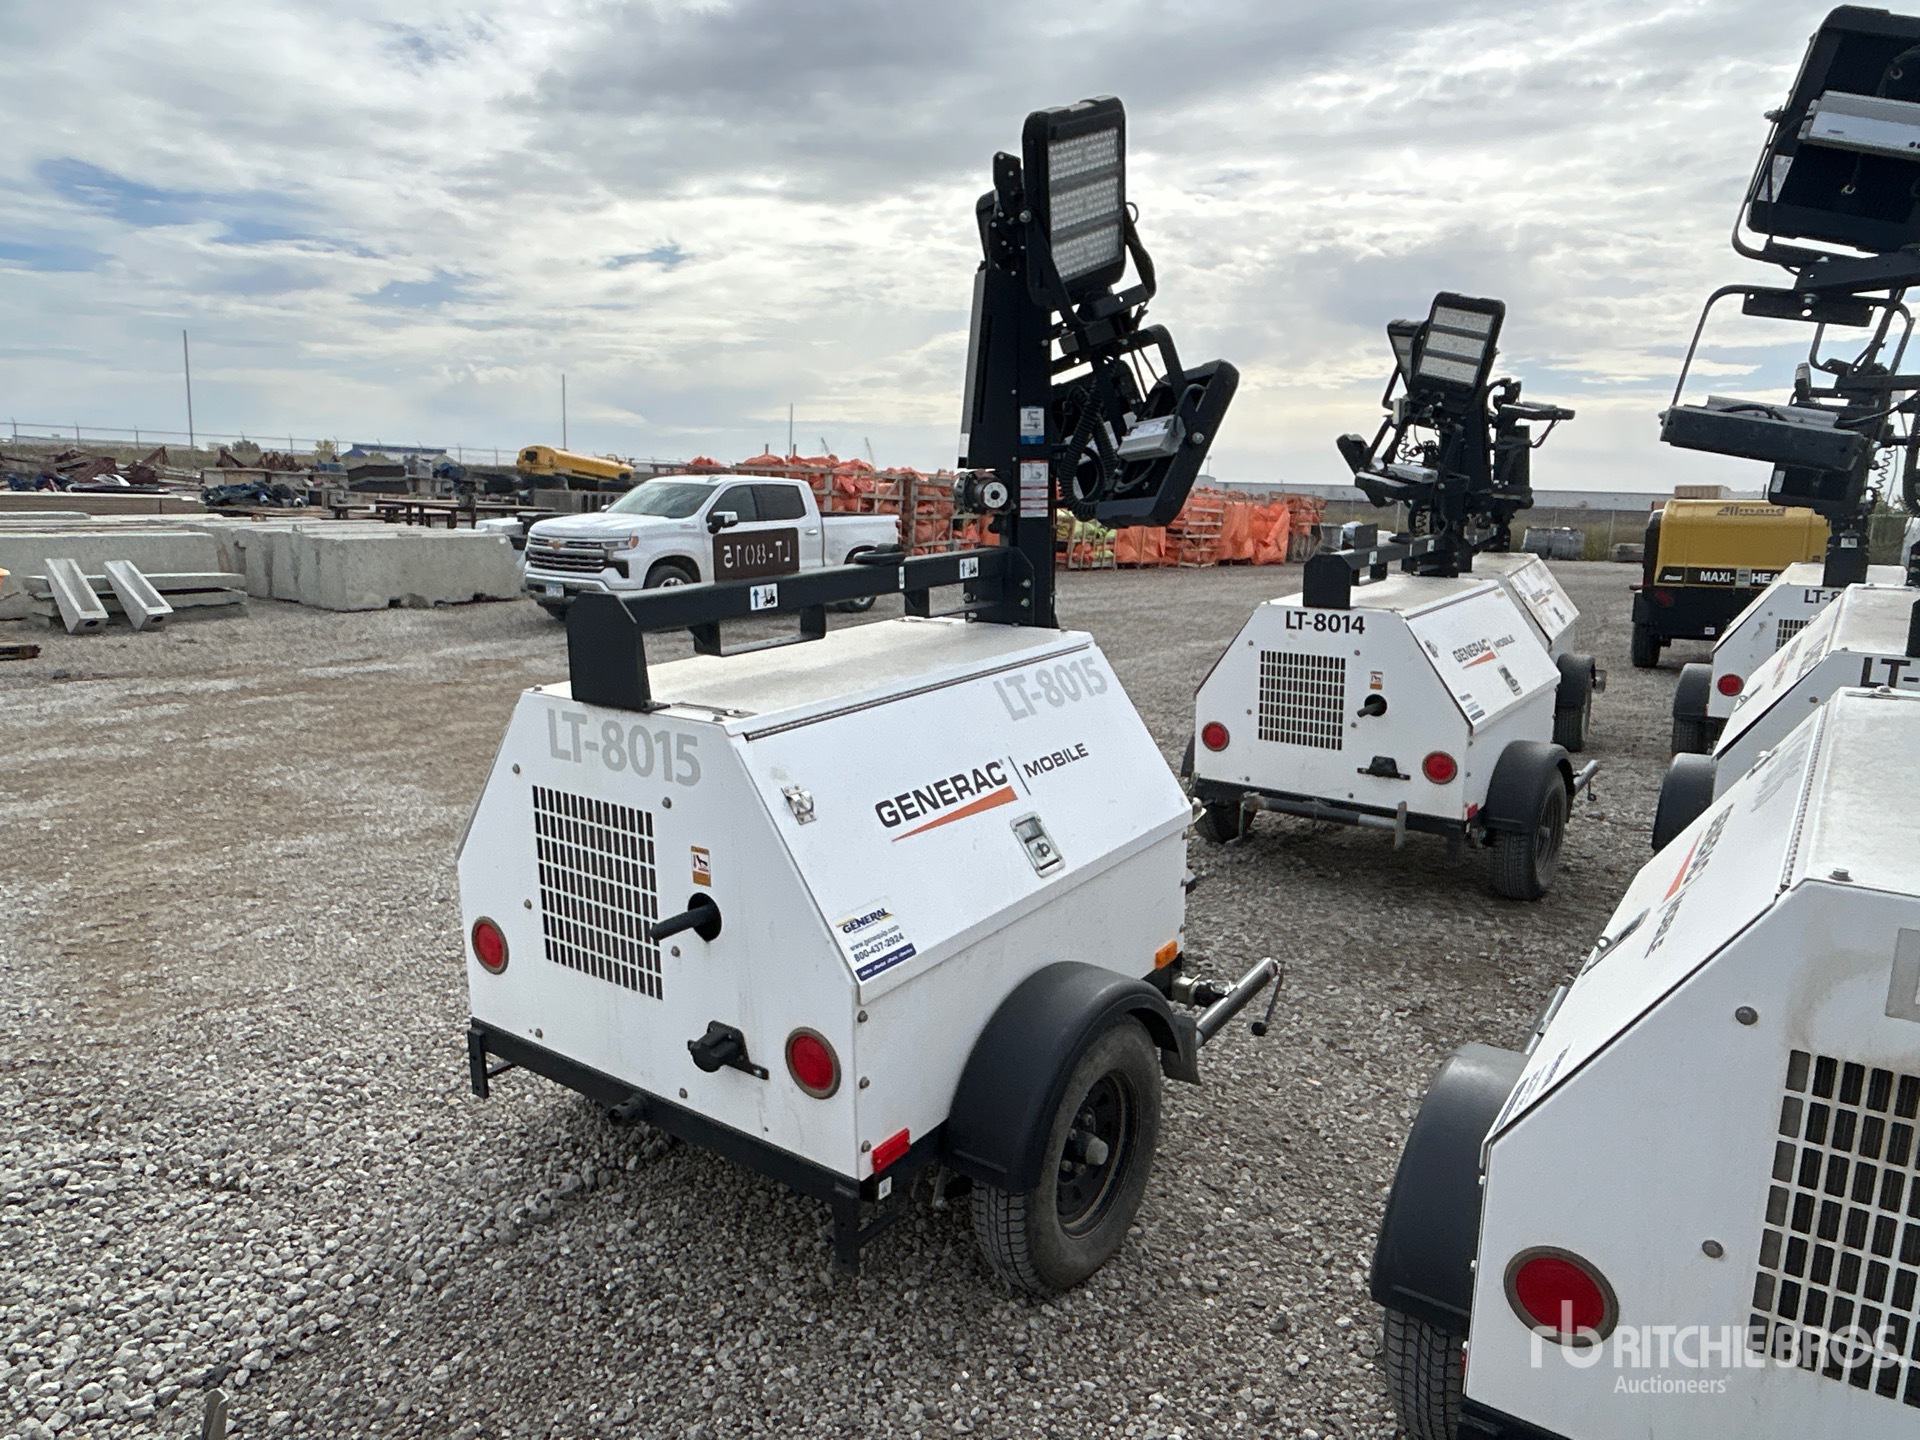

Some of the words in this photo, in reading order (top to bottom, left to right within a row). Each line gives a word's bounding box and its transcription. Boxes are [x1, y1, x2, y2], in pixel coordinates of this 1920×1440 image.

[1717, 506, 1785, 516] Allmand
[1700, 571, 1735, 582] MAXI-
[1751, 572, 1783, 584] HEA
[1804, 589, 1841, 604] LT-8
[1285, 610, 1366, 634] LT-8014
[1452, 638, 1491, 663] GENERAC
[1860, 657, 1920, 688] LT-
[993, 657, 1108, 721] LT-8015
[547, 708, 701, 787] LT-8015
[875, 761, 1008, 828] GENERAC
[1023, 742, 1089, 778] MOBILE
[842, 908, 889, 933] GENERAL
[853, 933, 904, 962] 800-437-2924
